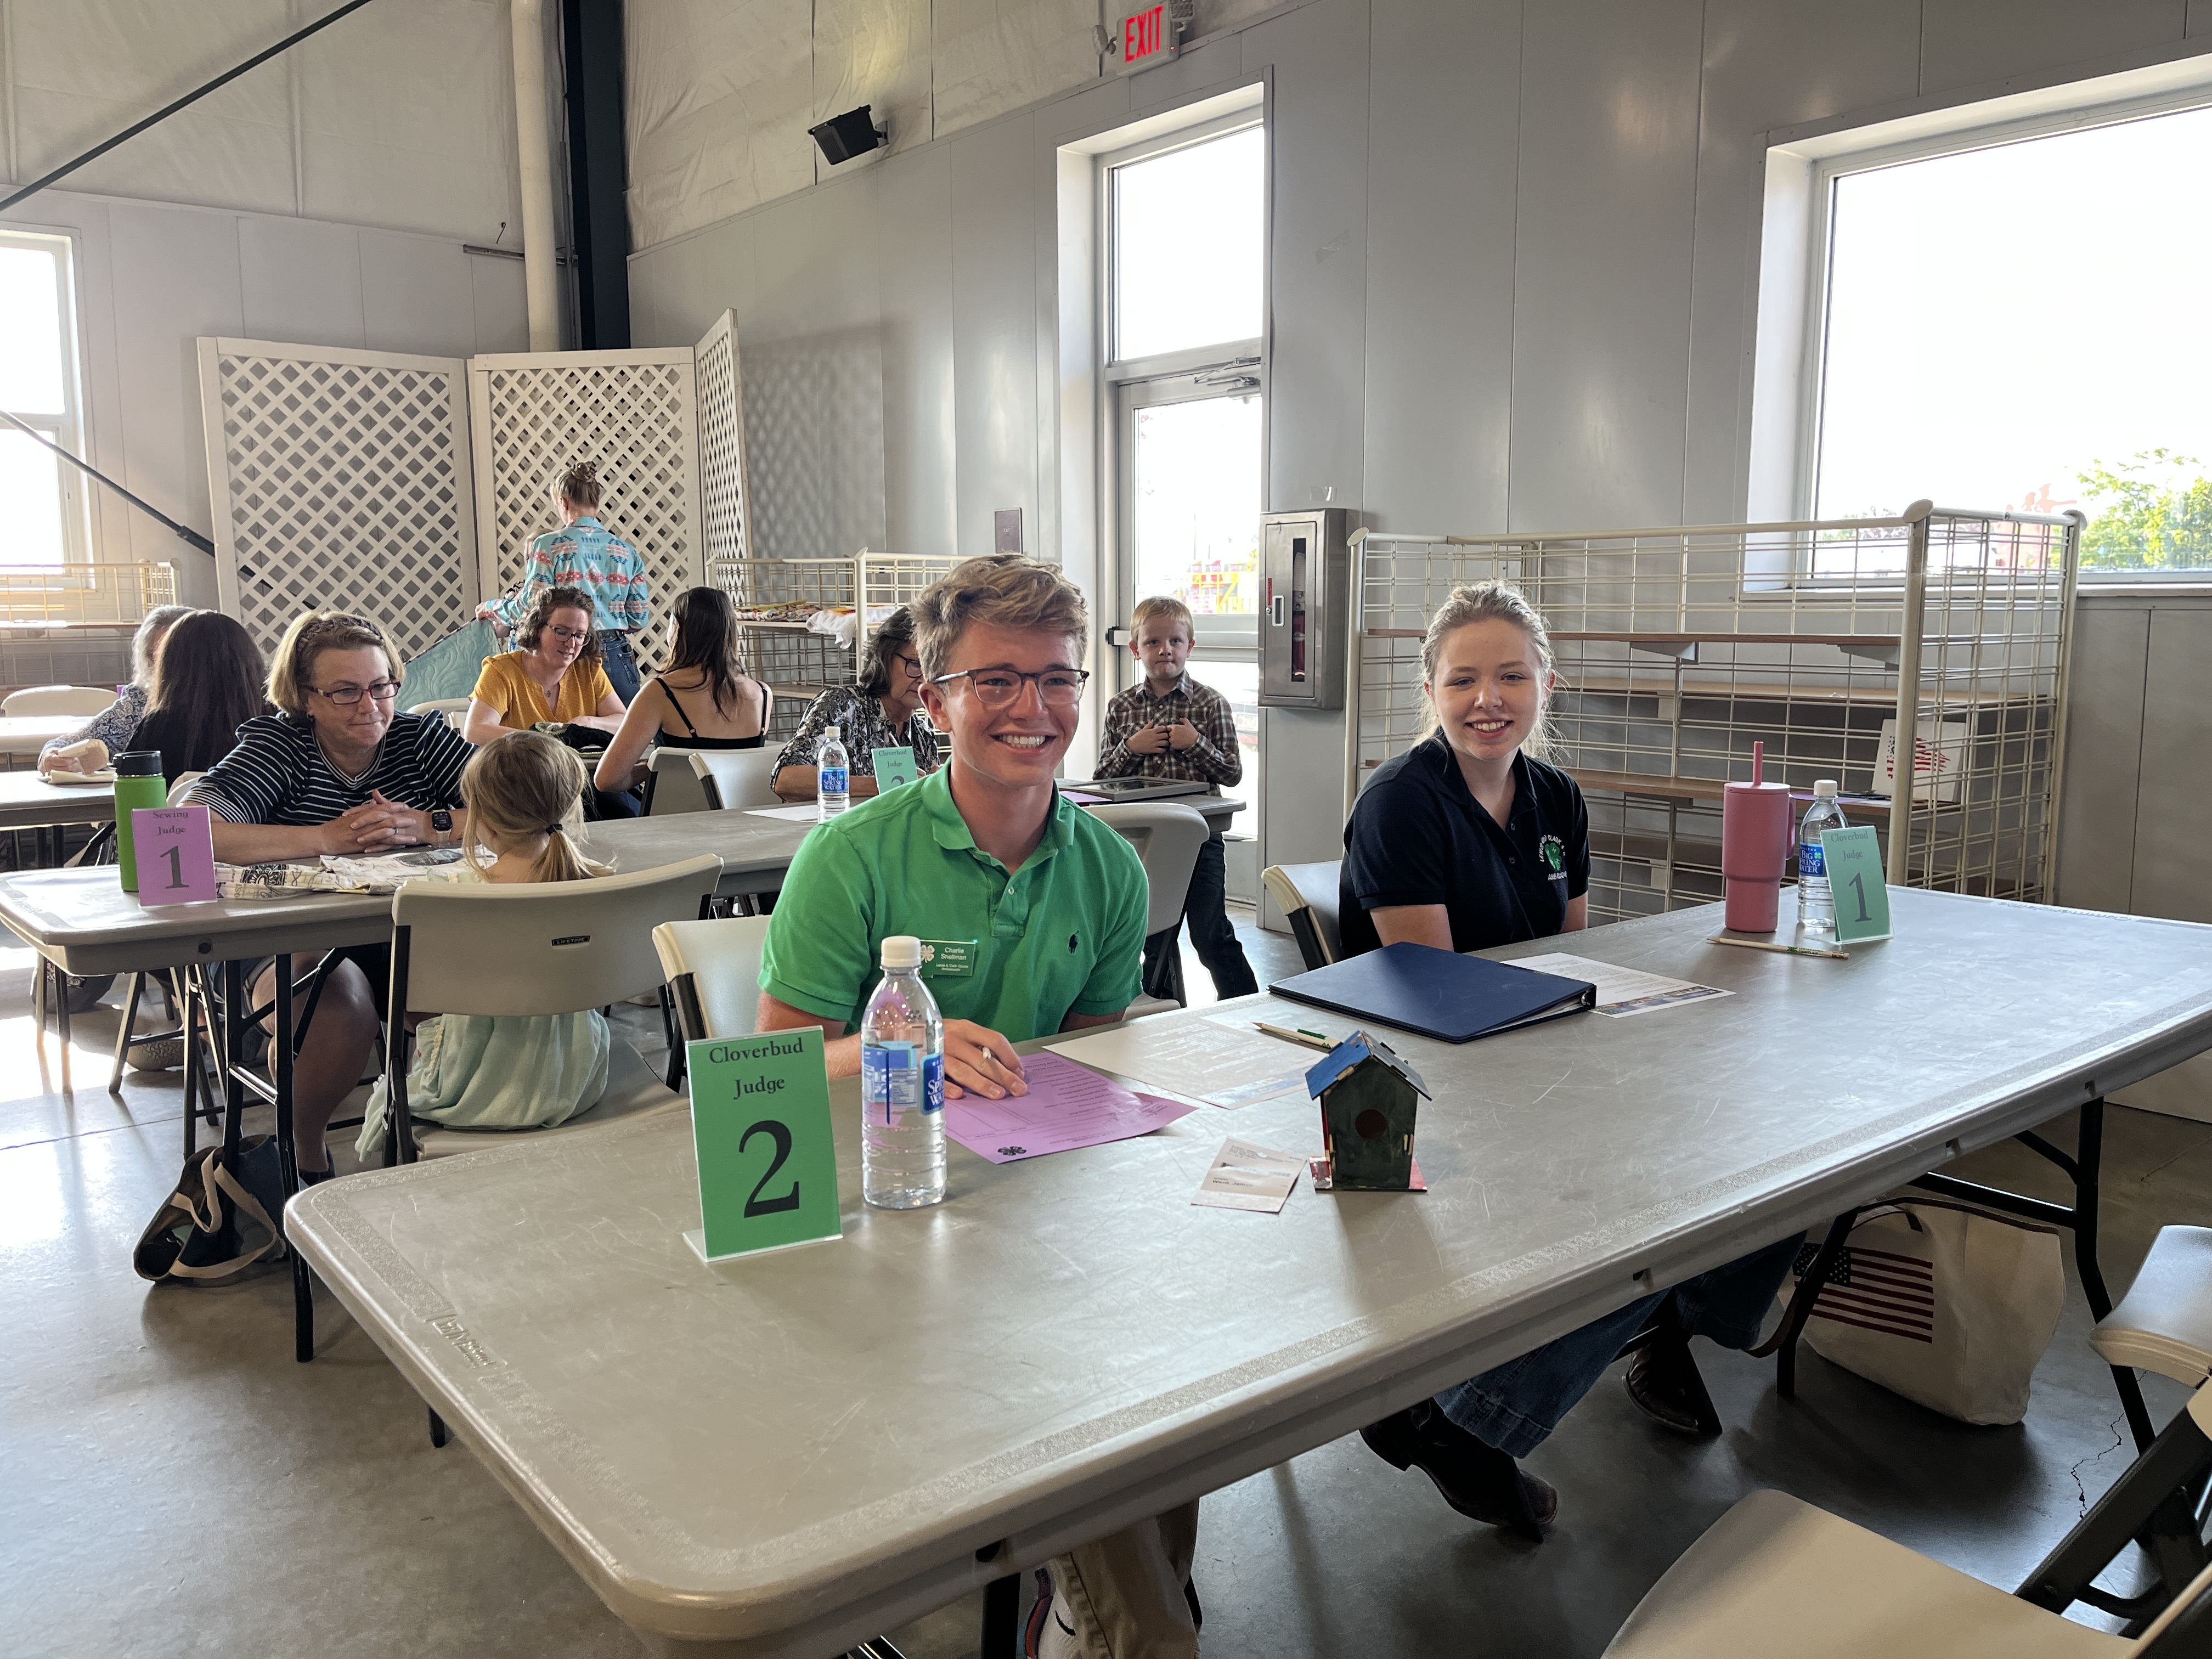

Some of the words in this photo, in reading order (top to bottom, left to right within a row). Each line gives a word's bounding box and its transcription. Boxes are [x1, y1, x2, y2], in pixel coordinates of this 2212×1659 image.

[1125, 4, 1164, 63] EXIT
[153, 810, 189, 820] Sewing
[156, 825, 186, 837] Judge
[1830, 830, 1869, 843] Cloverbud
[1548, 834, 1562, 845] CLARK
[1802, 850, 1813, 860] BIG
[1842, 849, 1864, 862] Judge
[159, 845, 189, 889] 1
[1800, 858, 1821, 867] PRING
[1848, 872, 1872, 923] 1
[709, 1037, 804, 1064] Cloverbud
[733, 1075, 786, 1100] Judge
[738, 1120, 799, 1218] 2
